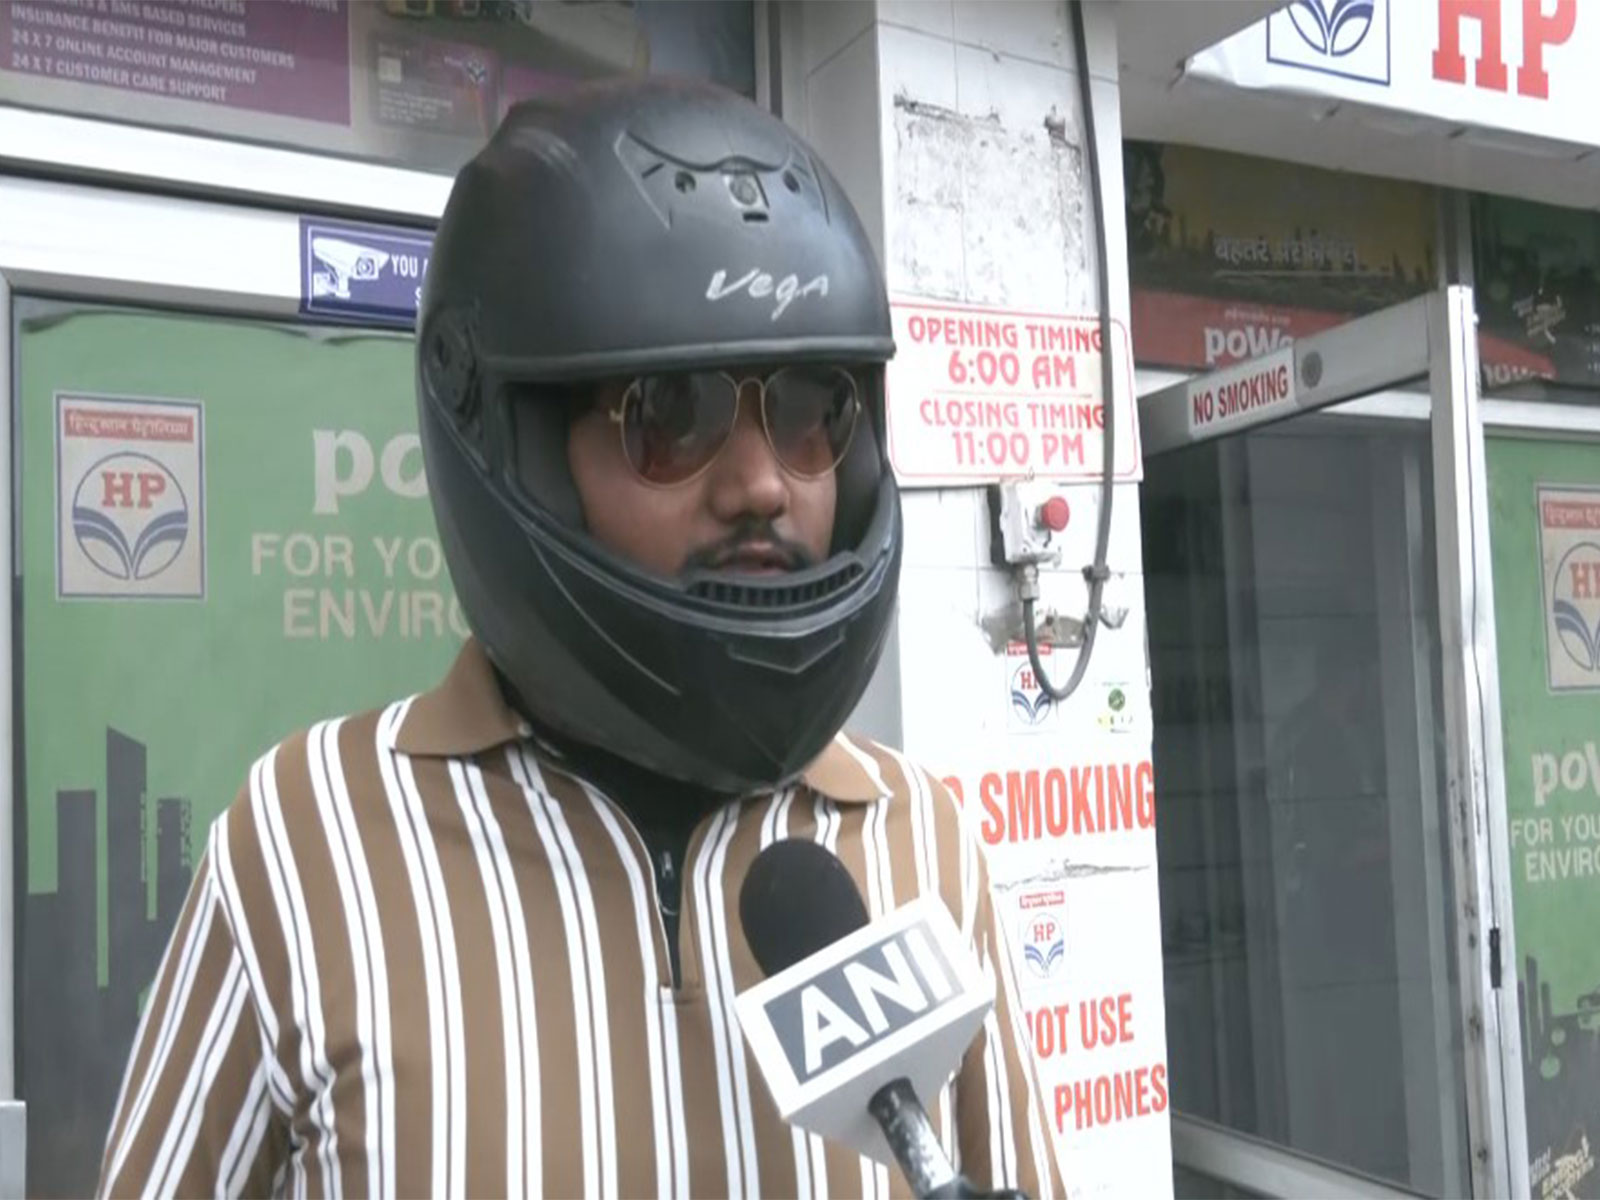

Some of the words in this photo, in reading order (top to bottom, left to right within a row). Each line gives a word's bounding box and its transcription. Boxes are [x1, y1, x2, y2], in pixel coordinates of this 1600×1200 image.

[11, 3, 90, 32] INSURANCE
[92, 19, 145, 41] BENEFIT
[148, 28, 173, 47] FOR
[175, 33, 218, 52] MAJOR
[219, 42, 295, 69] CUSTOMERS
[11, 27, 30, 45] 24
[32, 32, 42, 47] X
[45, 34, 53, 48] 7
[55, 36, 105, 58] ONLINE
[106, 45, 168, 68] ACCOUNT
[169, 56, 257, 85] MANAGEMENT
[11, 52, 30, 69] 24
[32, 55, 42, 71] X
[45, 57, 53, 73] 7
[56, 60, 130, 86] CUSTOMER
[132, 73, 168, 92] CARE
[168, 77, 227, 101] SUPPORT
[391, 253, 418, 278] YOU
[908, 315, 1019, 348] OPENING
[1024, 324, 1104, 353] TIMING
[948, 350, 1020, 386] 6:00
[1031, 355, 1077, 389] AM
[919, 398, 1020, 428] CLOSING
[1027, 402, 1105, 431] TIMING
[1193, 389, 1213, 425] NO
[1217, 364, 1289, 418] SMOKING
[951, 431, 1030, 466] 11:00
[1041, 433, 1085, 466] PM
[101, 470, 167, 509] HP
[250, 532, 355, 579] FOR
[979, 760, 1155, 846] SMOKING
[1511, 819, 1554, 848] FOR
[1033, 921, 1056, 943] HP
[800, 926, 952, 1076] ANI
[1078, 992, 1135, 1050] USE
[1053, 1062, 1168, 1135] PHONES
